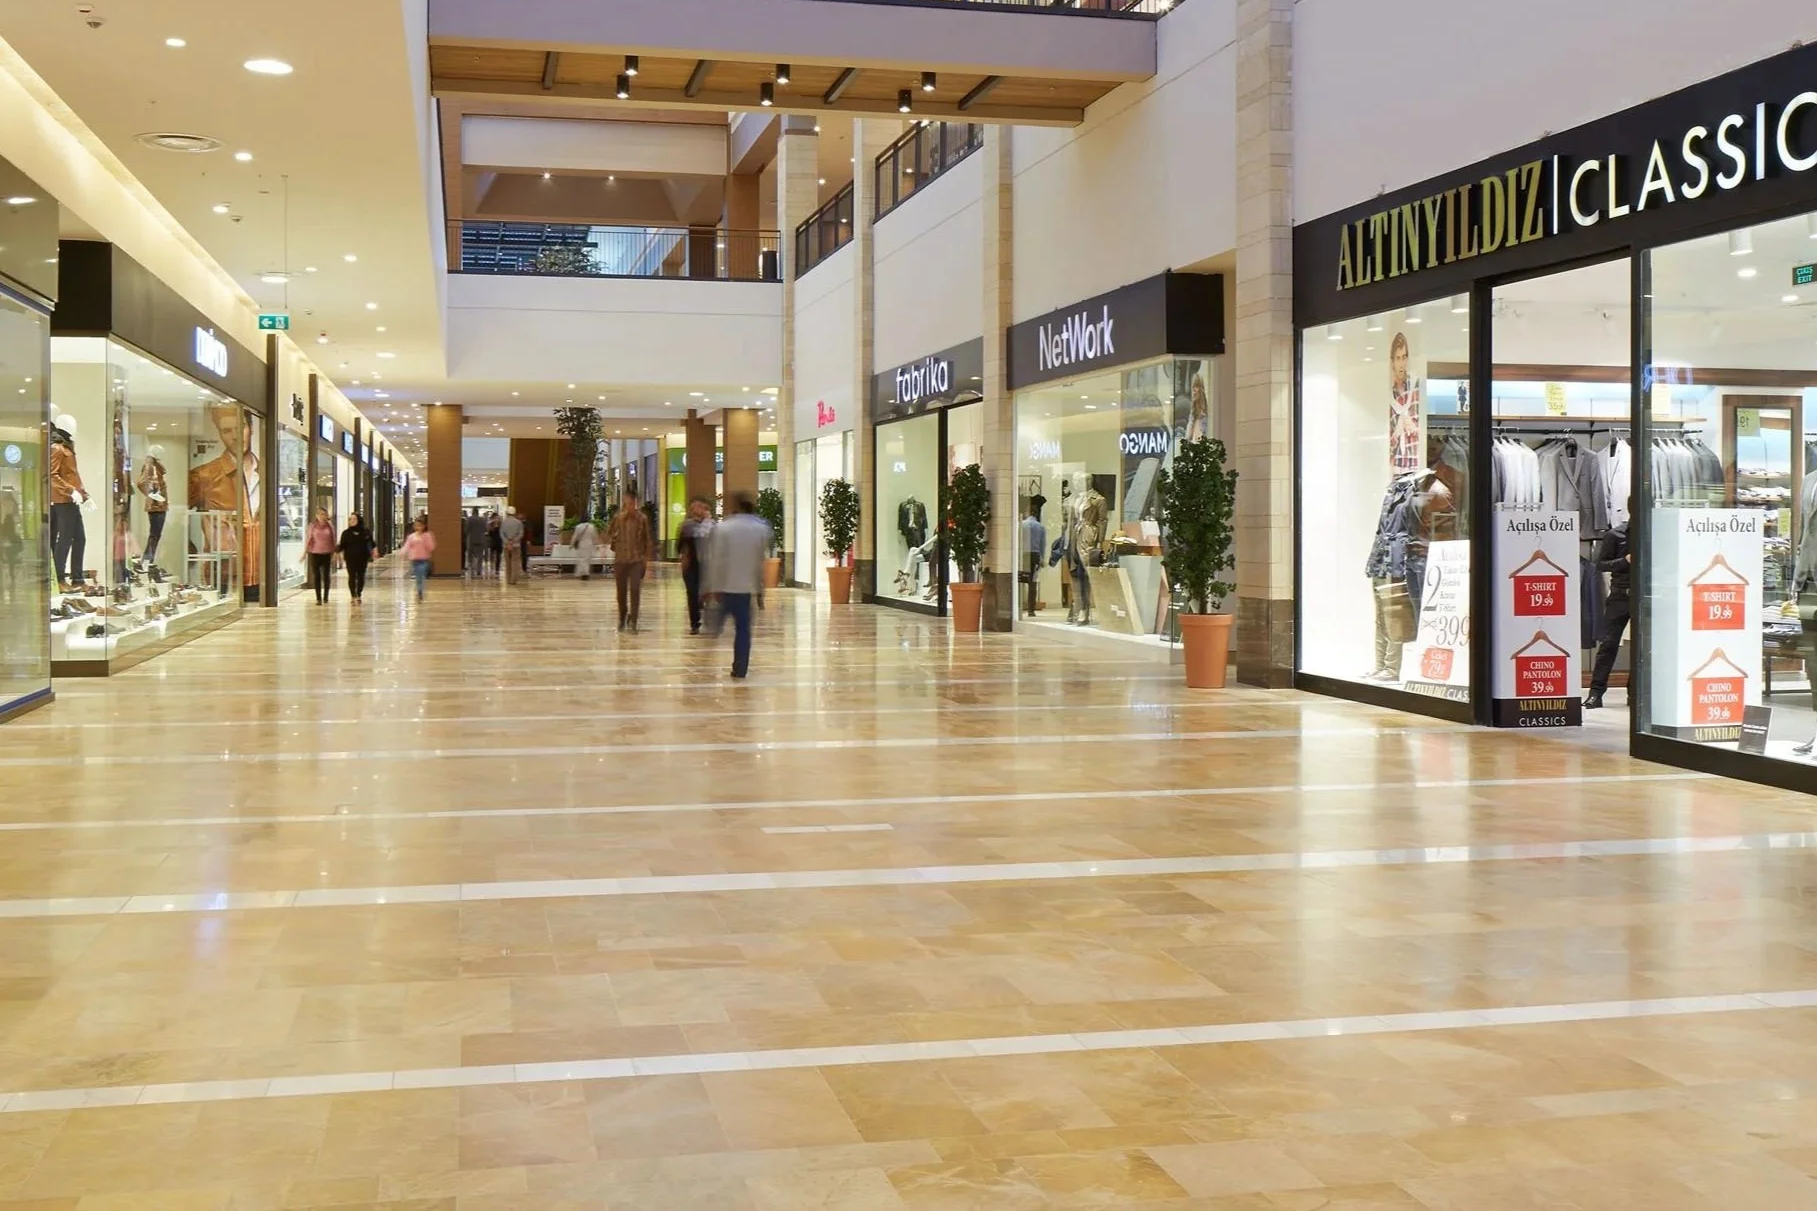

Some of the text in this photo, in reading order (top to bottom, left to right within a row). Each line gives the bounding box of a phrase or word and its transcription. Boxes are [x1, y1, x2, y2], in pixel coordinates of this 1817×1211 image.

[1336, 91, 1817, 292] ALTINYILDIZ CLASSIC
[1797, 274, 1813, 284] EXIT
[1039, 304, 1115, 371] NetWork
[895, 357, 949, 404] fabrika
[1506, 515, 1574, 535] Açılışa Özel
[1686, 514, 1756, 536] Açılışa Özel
[1524, 582, 1557, 592] T-SHIRT
[1703, 591, 1736, 602] T-SHIRT
[1530, 661, 1555, 669] CHINO
[1523, 670, 1562, 679] PANTOLON
[1707, 683, 1732, 693] CHINO
[1699, 693, 1739, 704] PANTOLON
[1518, 716, 1566, 727] CLASSICS
